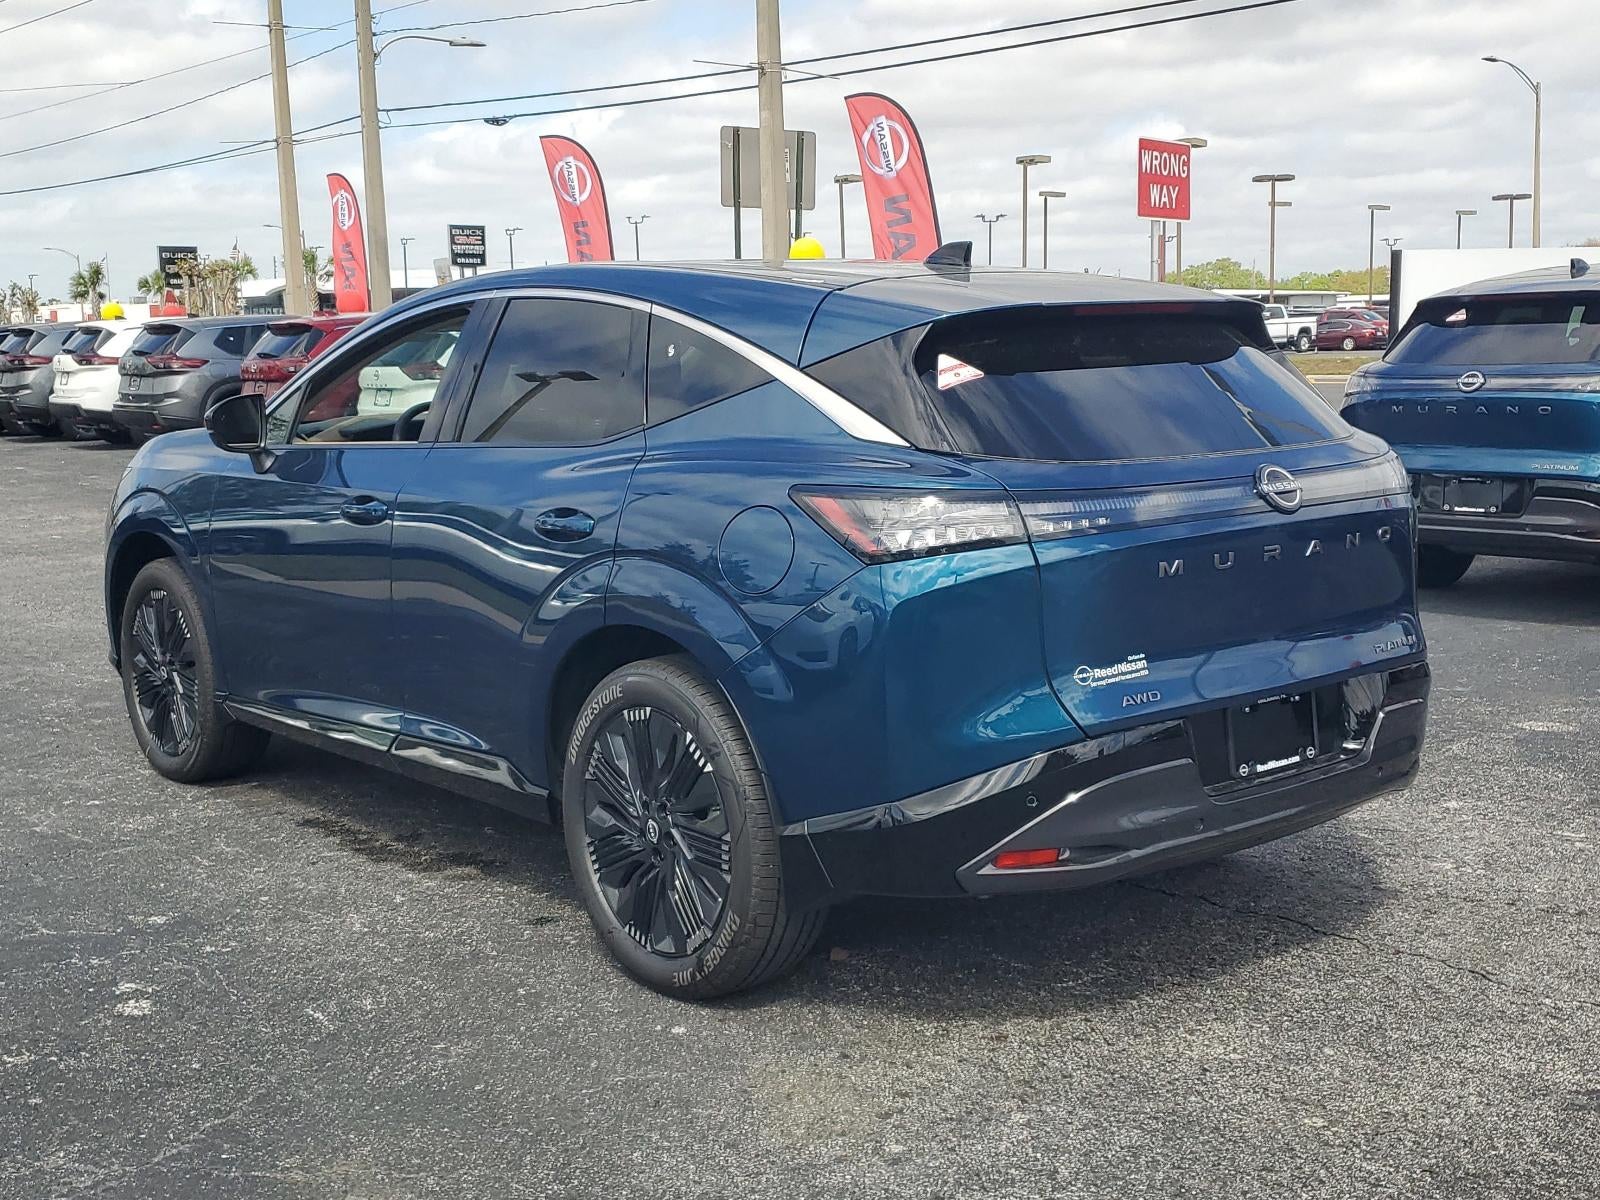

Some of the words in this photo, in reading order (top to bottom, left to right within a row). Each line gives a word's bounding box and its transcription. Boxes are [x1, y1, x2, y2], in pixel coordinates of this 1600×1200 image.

[1141, 149, 1188, 178] WRONG
[1150, 183, 1179, 209] WAY
[454, 236, 482, 244] GMC
[1391, 405, 1552, 415] MURANO
[1531, 463, 1579, 471] PLATINUM
[1262, 480, 1302, 492] NISSAN
[1158, 526, 1392, 578] MURANO
[1122, 690, 1161, 708] AWD
[569, 682, 624, 766] BRIDGESTONE
